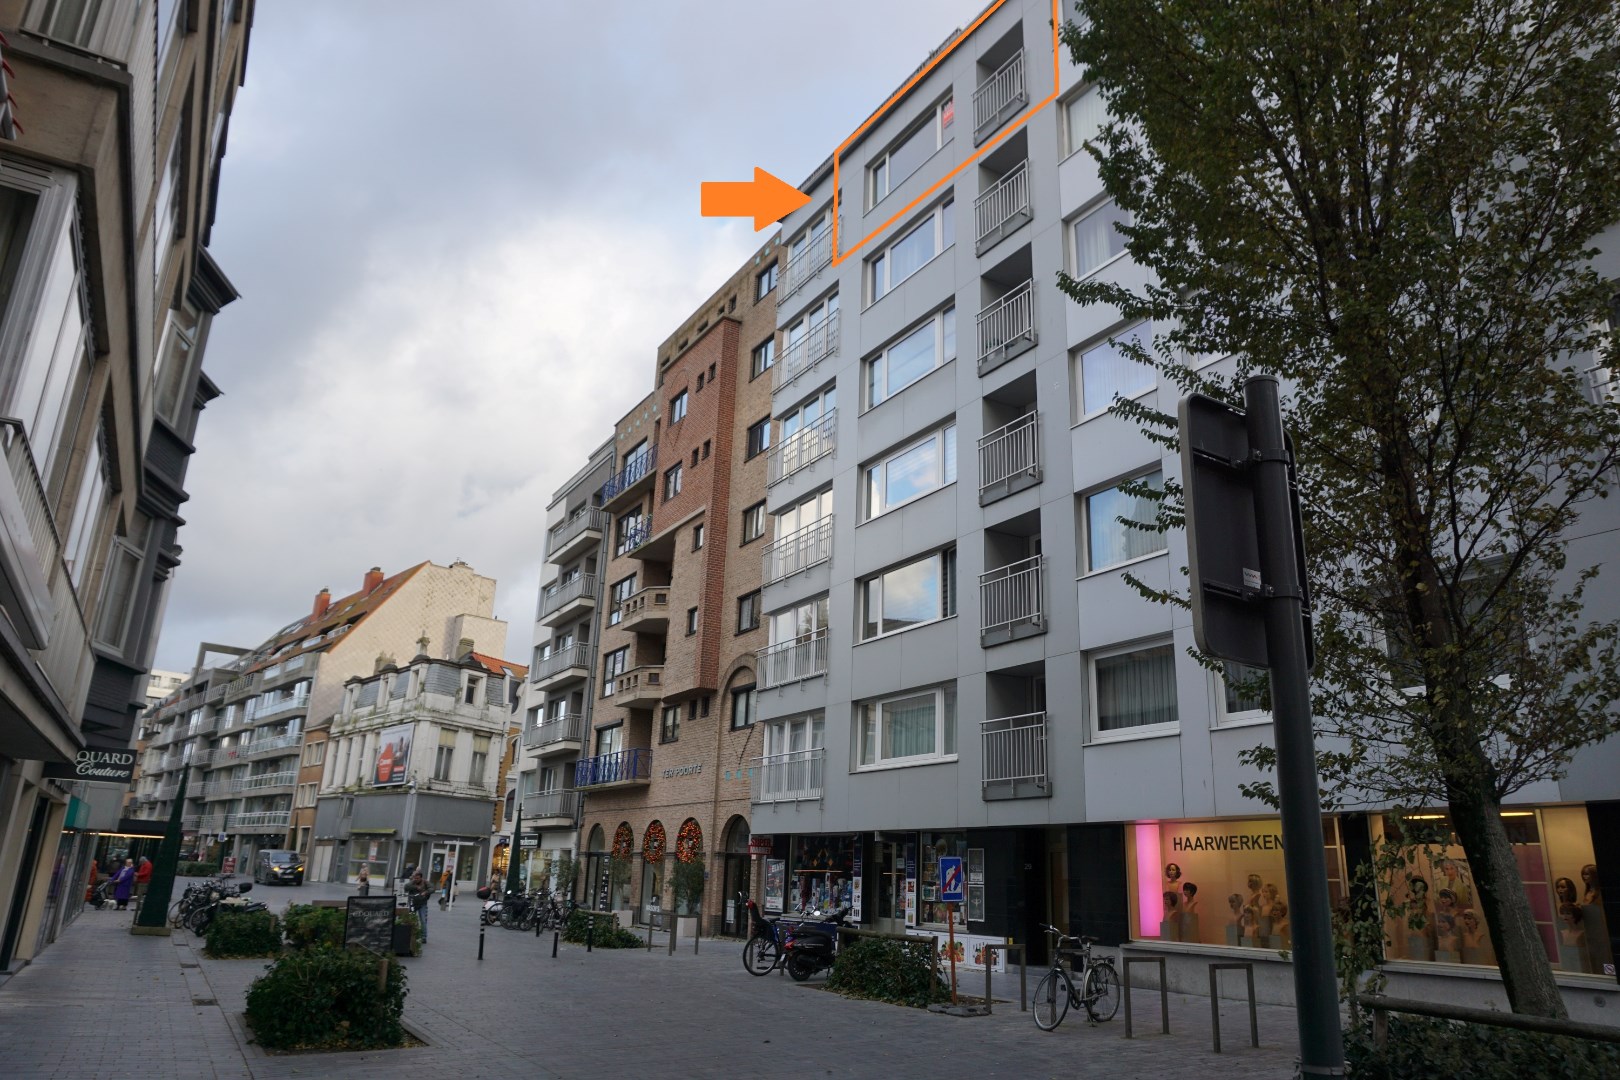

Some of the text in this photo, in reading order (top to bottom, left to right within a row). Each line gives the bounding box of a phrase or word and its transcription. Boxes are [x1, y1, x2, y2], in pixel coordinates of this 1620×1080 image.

[75, 760, 130, 778] Couture
[662, 763, 703, 779] TER POORTE
[750, 846, 772, 854] MARKET
[751, 837, 771, 847] SUPER
[1173, 834, 1284, 851] HAARWERKEN
